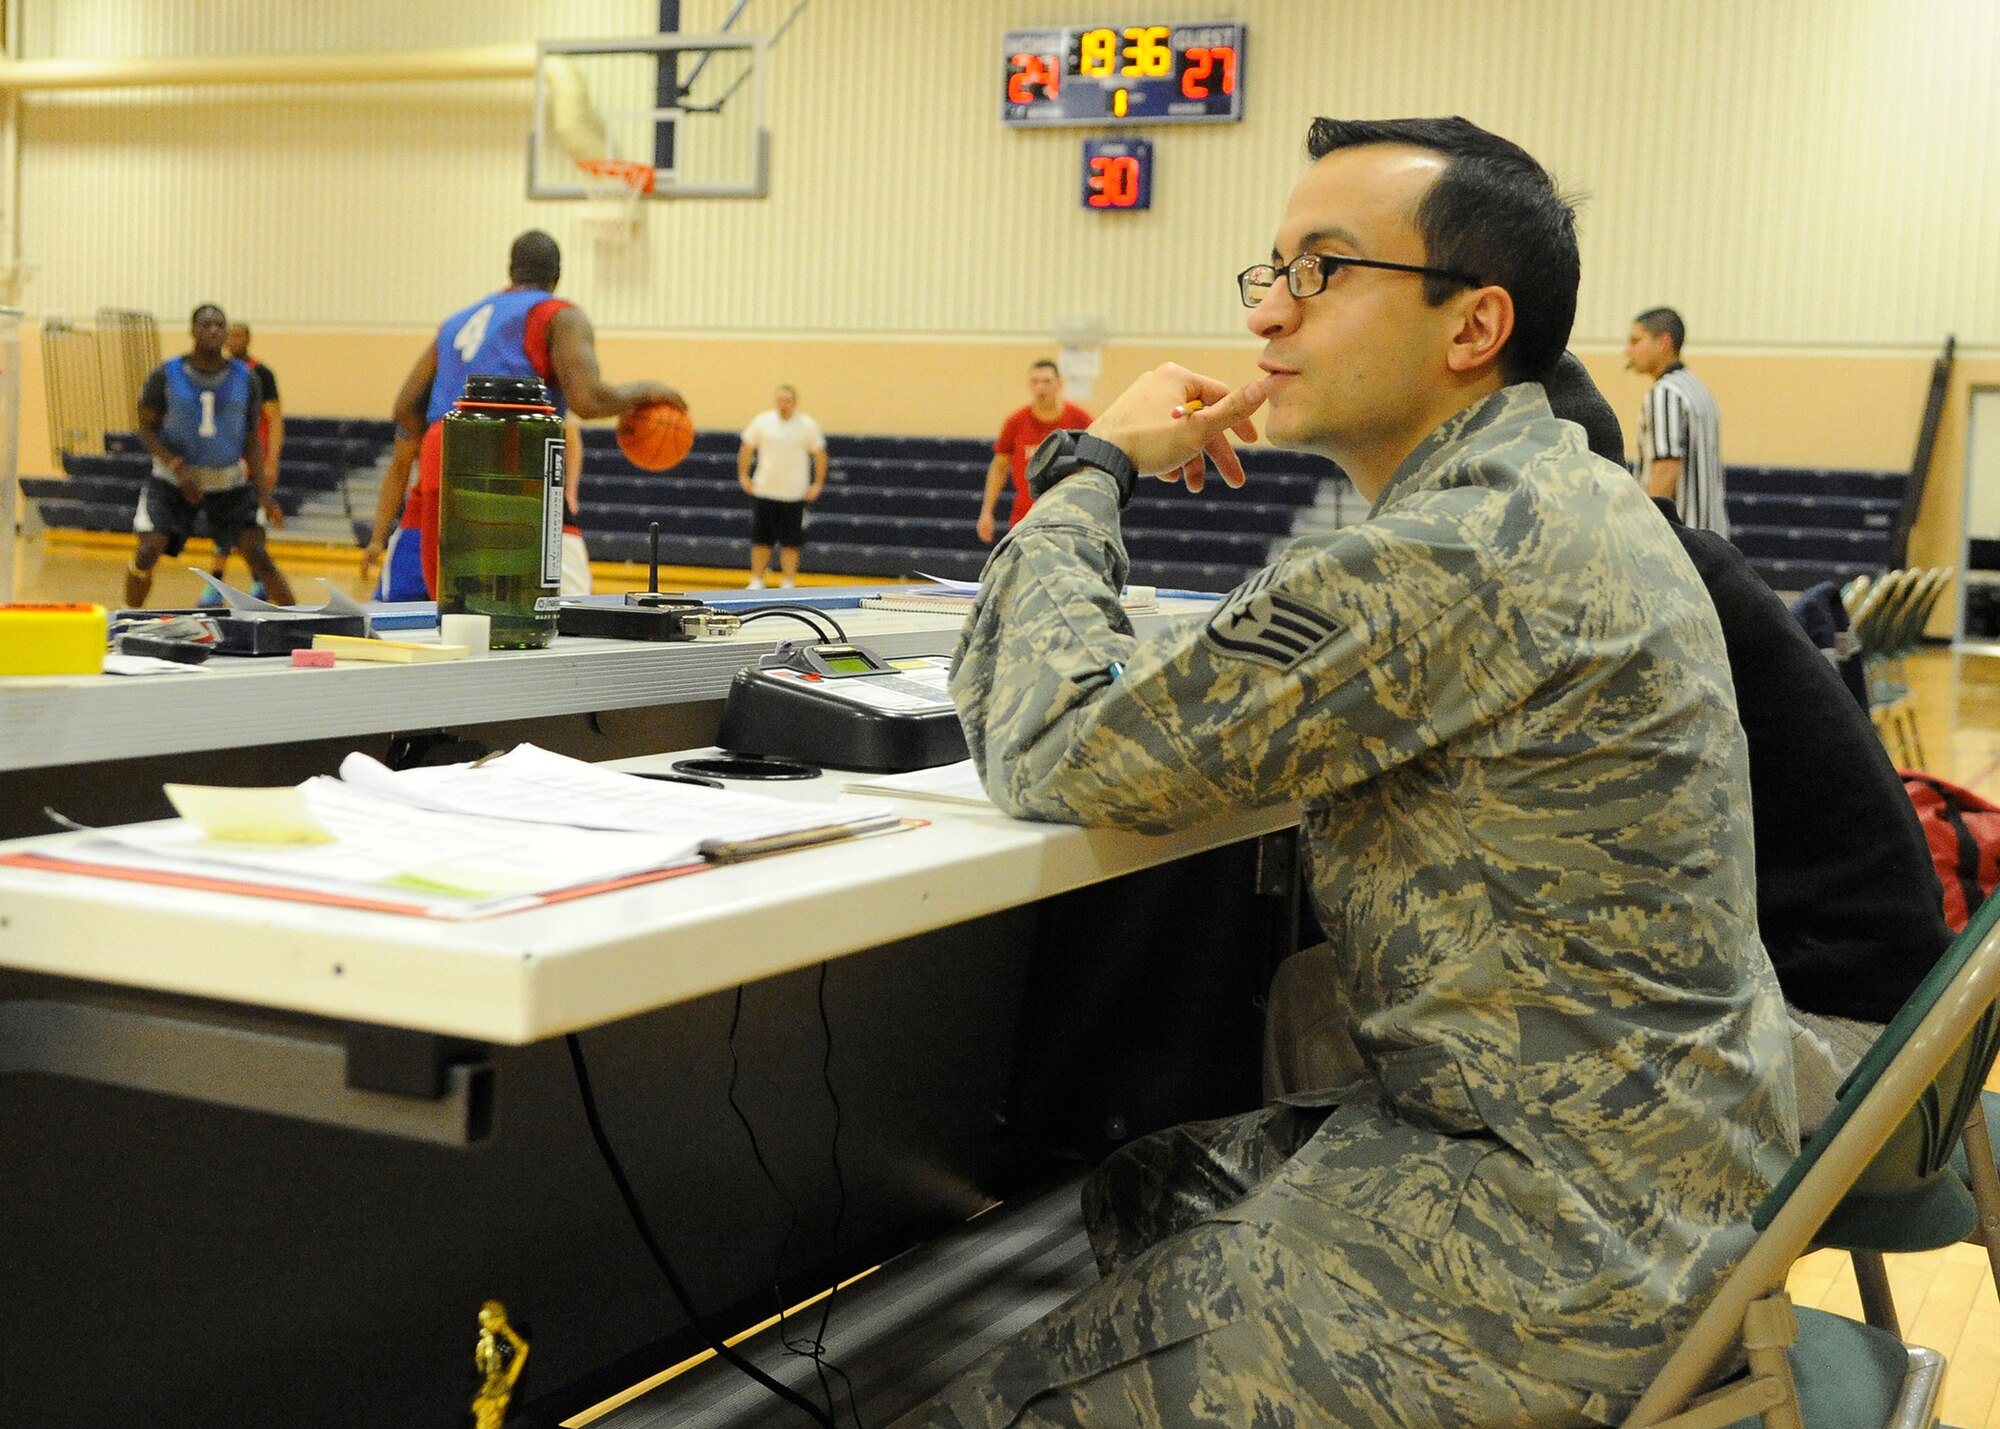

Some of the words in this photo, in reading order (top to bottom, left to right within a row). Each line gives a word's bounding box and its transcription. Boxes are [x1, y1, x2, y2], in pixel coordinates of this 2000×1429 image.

[1008, 53, 1060, 104] 24
[1182, 47, 1236, 99] 27
[1113, 88, 1129, 118] 1
[1088, 156, 1140, 207] 30
[455, 305, 493, 362] 4
[199, 391, 216, 437] 1
